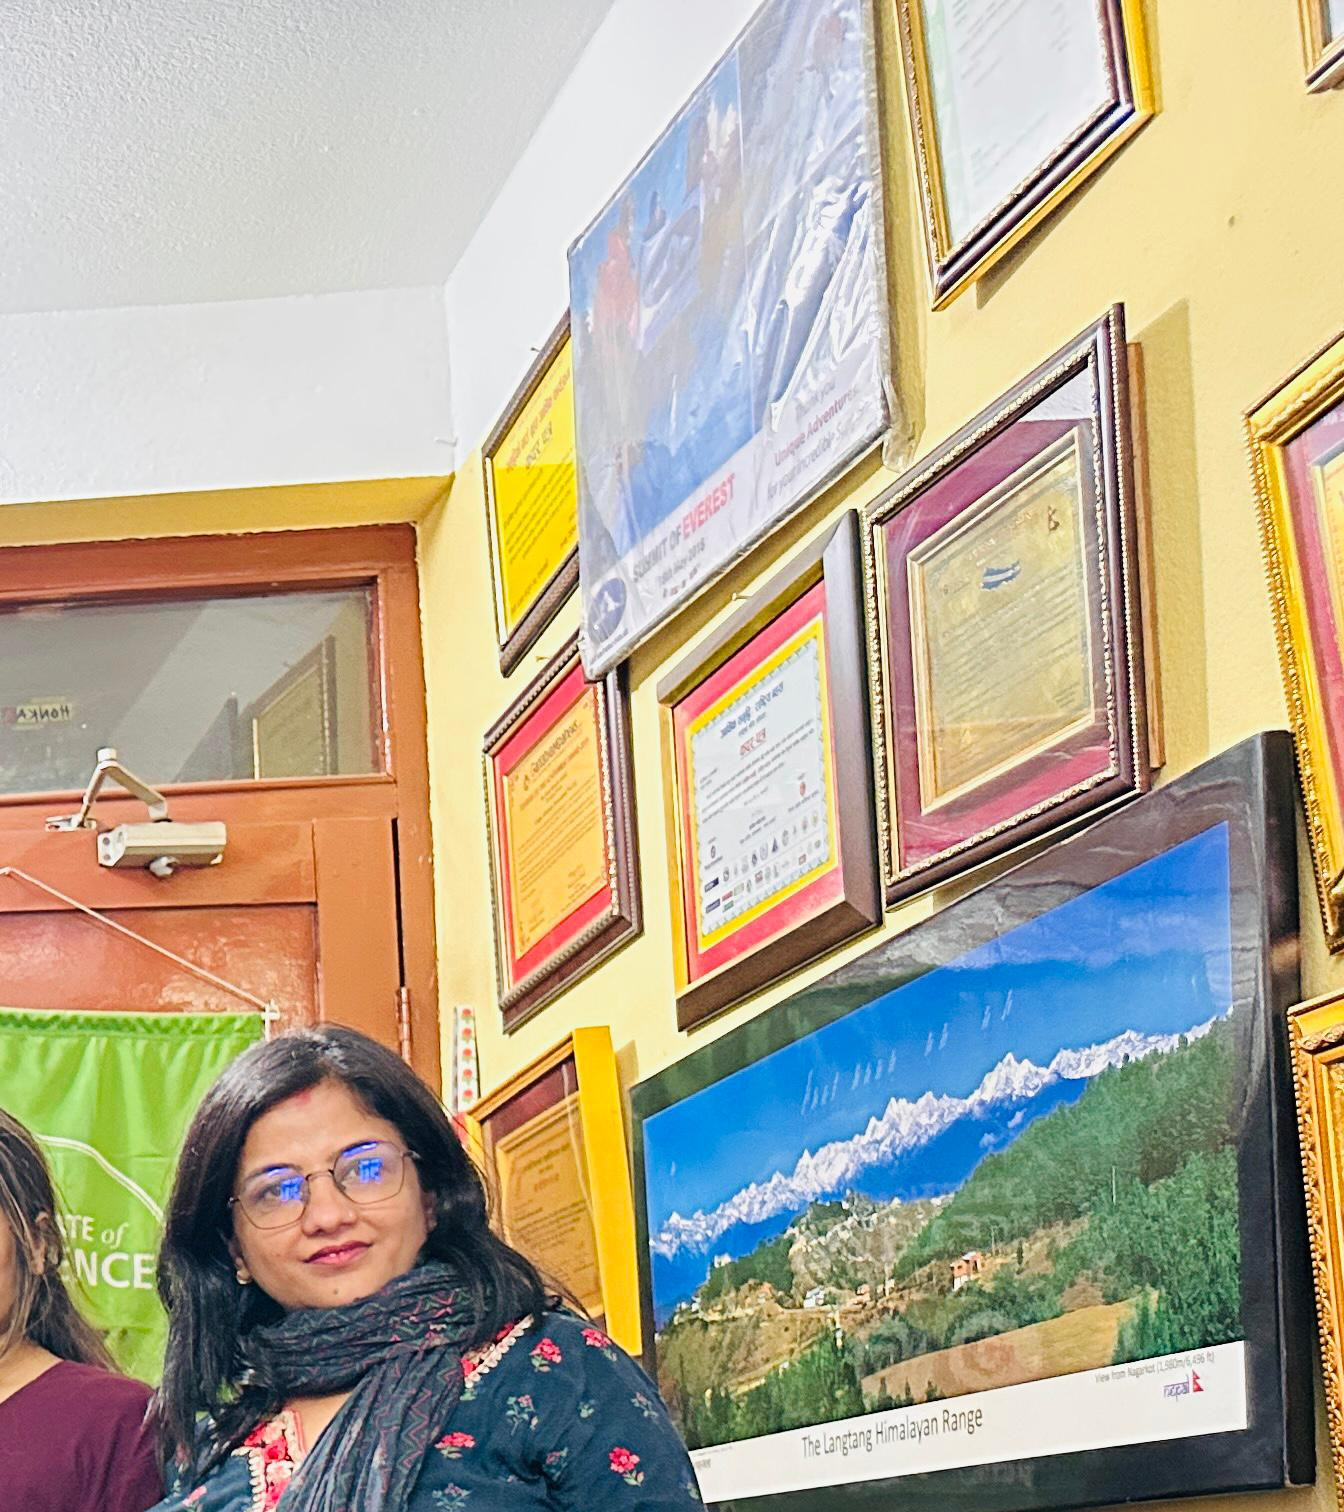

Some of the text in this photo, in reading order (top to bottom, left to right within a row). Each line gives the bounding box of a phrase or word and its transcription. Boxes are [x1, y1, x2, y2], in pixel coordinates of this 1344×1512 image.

[774, 432, 806, 467] Unique
[632, 473, 735, 584] SUMMIT OF EVEREST
[100, 1221, 129, 1250] of
[1127, 1363, 1156, 1379] Nagarkot
[1163, 1373, 1190, 1403] nepal
[801, 1407, 984, 1458] The Langtang Himalayan Range
